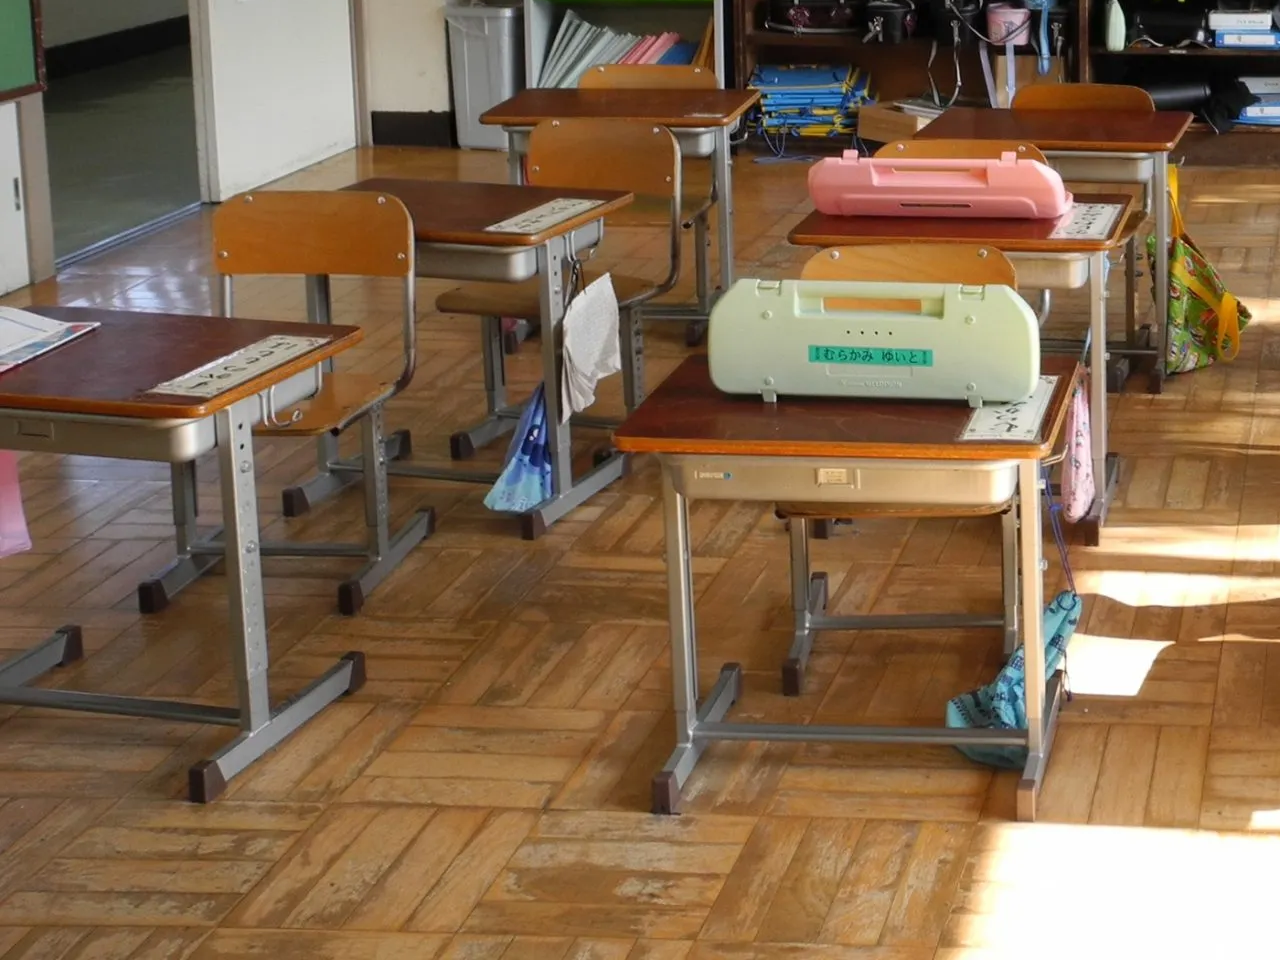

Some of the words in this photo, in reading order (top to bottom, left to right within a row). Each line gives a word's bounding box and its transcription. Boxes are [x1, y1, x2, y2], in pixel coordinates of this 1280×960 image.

[824, 347, 875, 362] むらかみ
[882, 350, 919, 364] ゆいと
